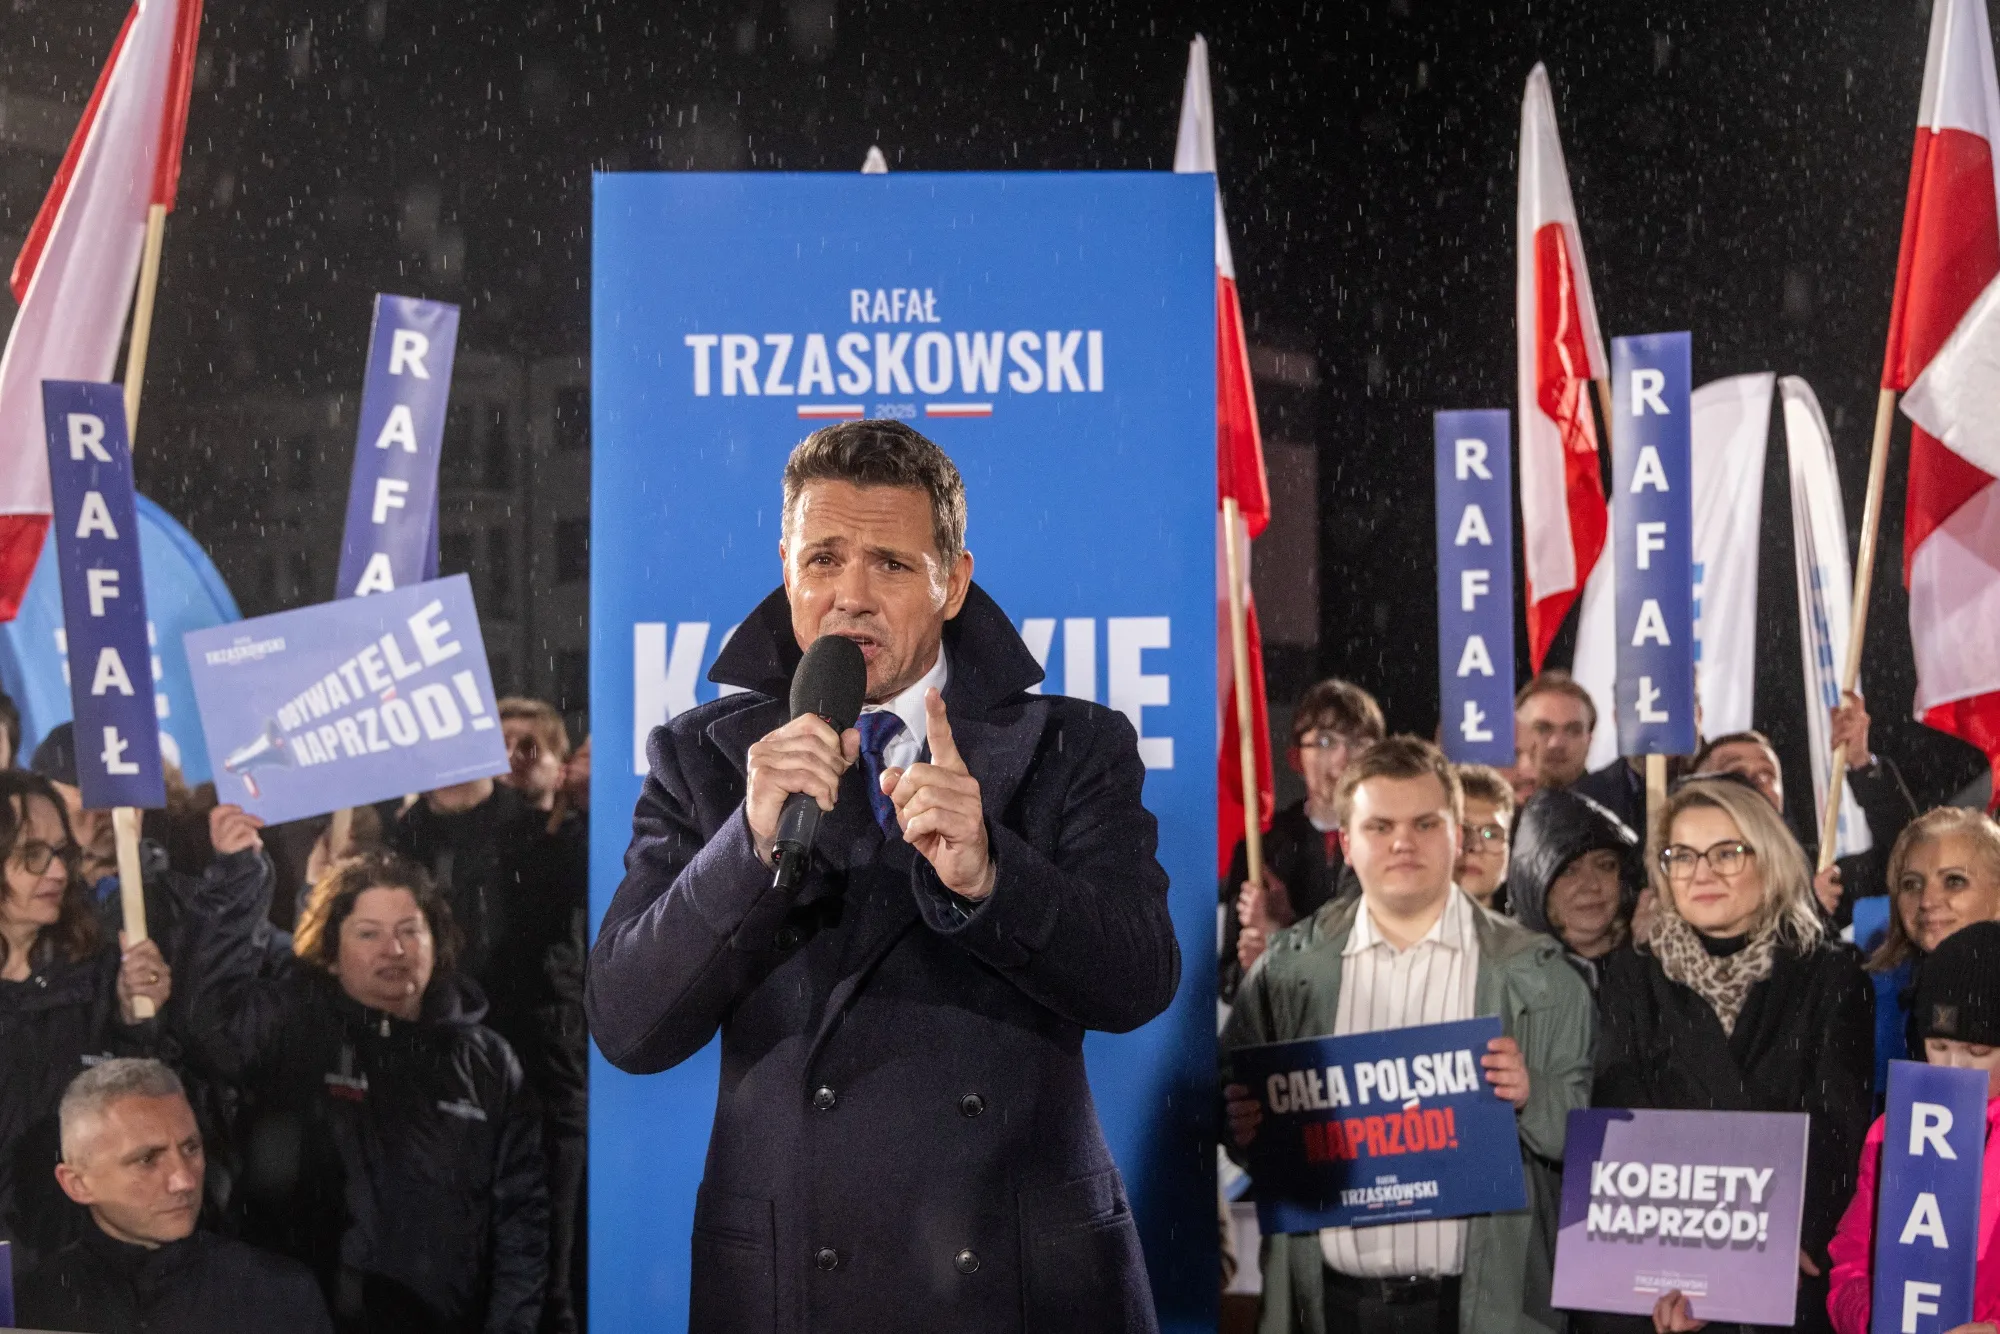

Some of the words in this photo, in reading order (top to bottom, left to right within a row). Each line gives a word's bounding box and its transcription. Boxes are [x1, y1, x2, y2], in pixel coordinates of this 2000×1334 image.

[850, 288, 942, 324] RAFAŁ
[685, 331, 1104, 397] TRZASKOWSKI
[875, 403, 917, 420] 2025
[1629, 368, 1671, 724] RAFAŁ
[66, 413, 141, 775] RAFAŁ
[1454, 438, 1494, 742] RAFAŁ
[277, 599, 463, 732] OBYWATELE
[291, 669, 497, 768] NAPRZÓD!
[1266, 1064, 1351, 1114] CAŁA
[1354, 1049, 1481, 1106] POLSKA
[1303, 1098, 1459, 1164] NAPRZÓD!
[1340, 1180, 1439, 1208] TRZASKOWSKI
[1590, 1160, 1774, 1204] KOBIETY
[1587, 1202, 1770, 1242] NAPRZÓD!
